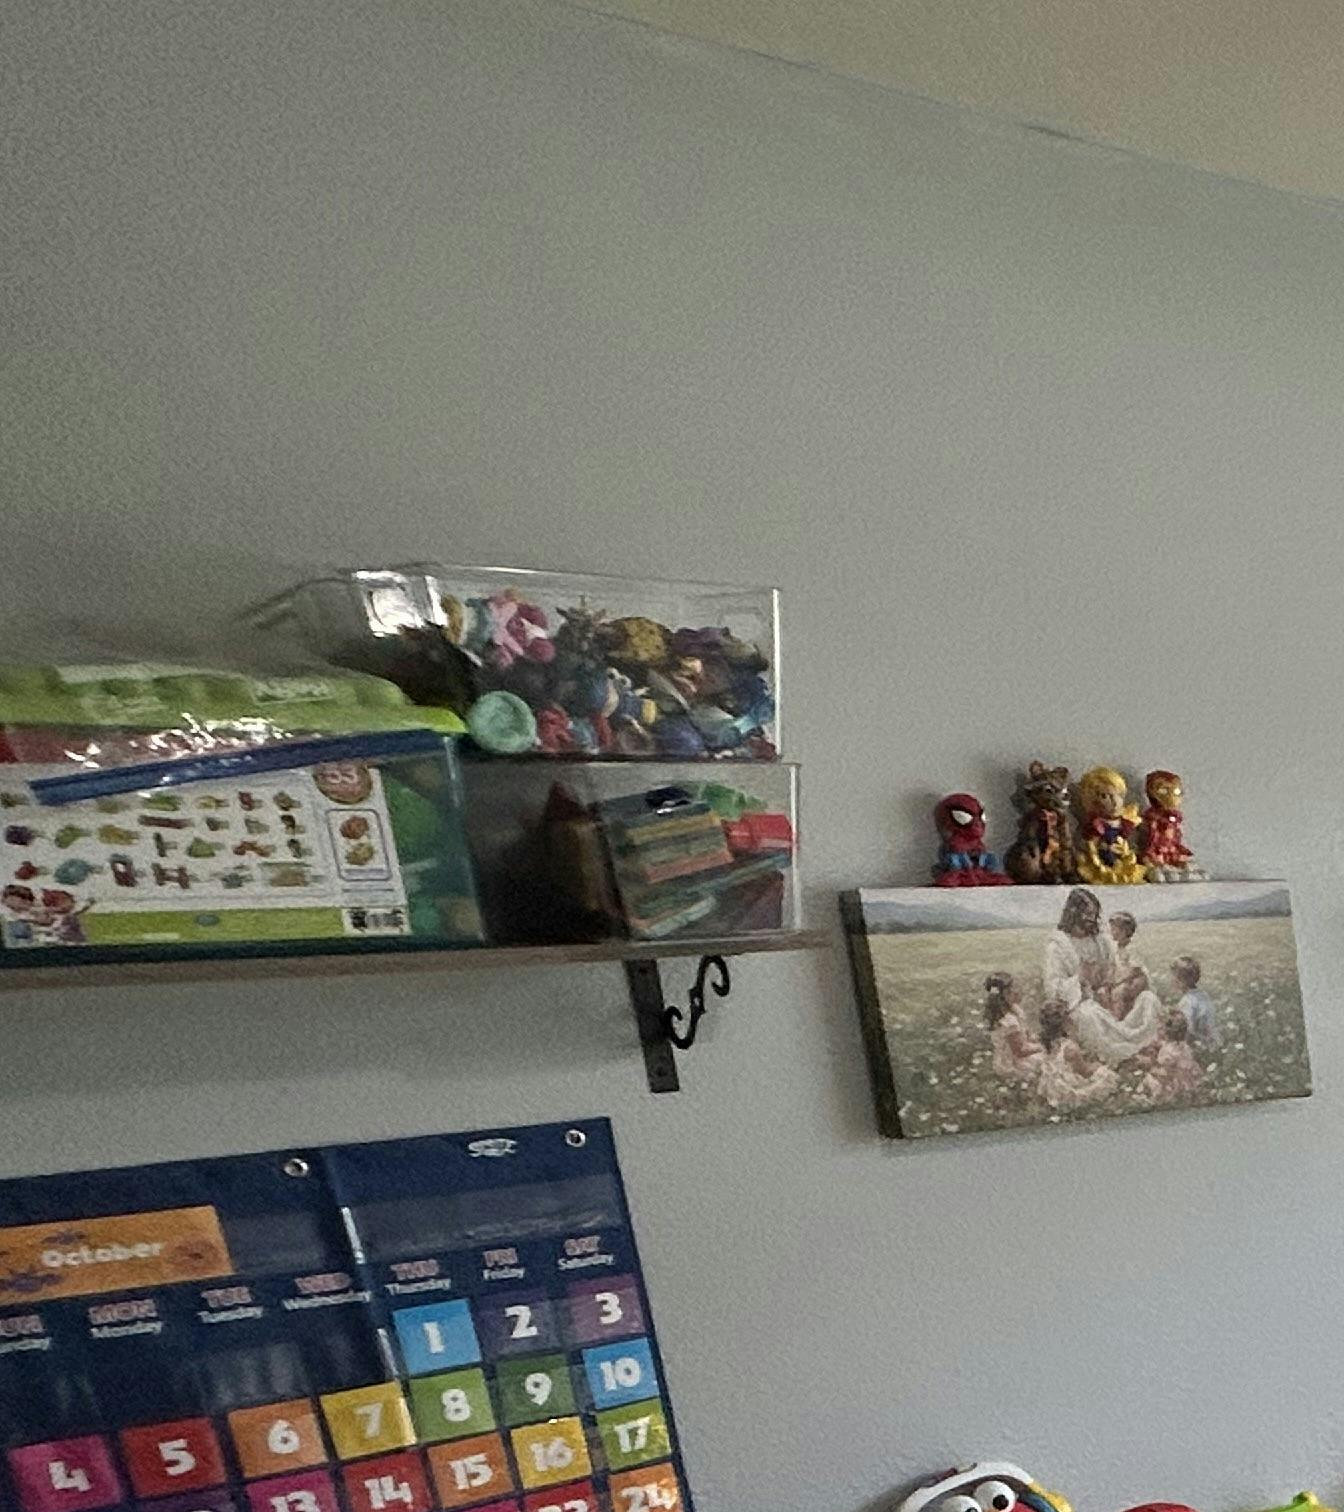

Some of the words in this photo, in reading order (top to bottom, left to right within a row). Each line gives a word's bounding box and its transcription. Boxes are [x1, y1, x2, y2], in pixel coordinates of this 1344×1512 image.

[41, 1242, 162, 1268] October
[423, 1321, 445, 1354] 1
[505, 1304, 538, 1339] 2
[595, 1291, 623, 1325] 3
[49, 1460, 92, 1493] 4
[158, 1437, 197, 1476] 5
[266, 1418, 301, 1454] 6
[353, 1401, 384, 1439] 7
[441, 1387, 472, 1422] 8
[524, 1371, 552, 1406] 9
[600, 1356, 642, 1392] 10
[363, 1474, 415, 1510] 14
[449, 1453, 494, 1490] 15
[530, 1435, 575, 1473] 16
[614, 1416, 650, 1453] 17
